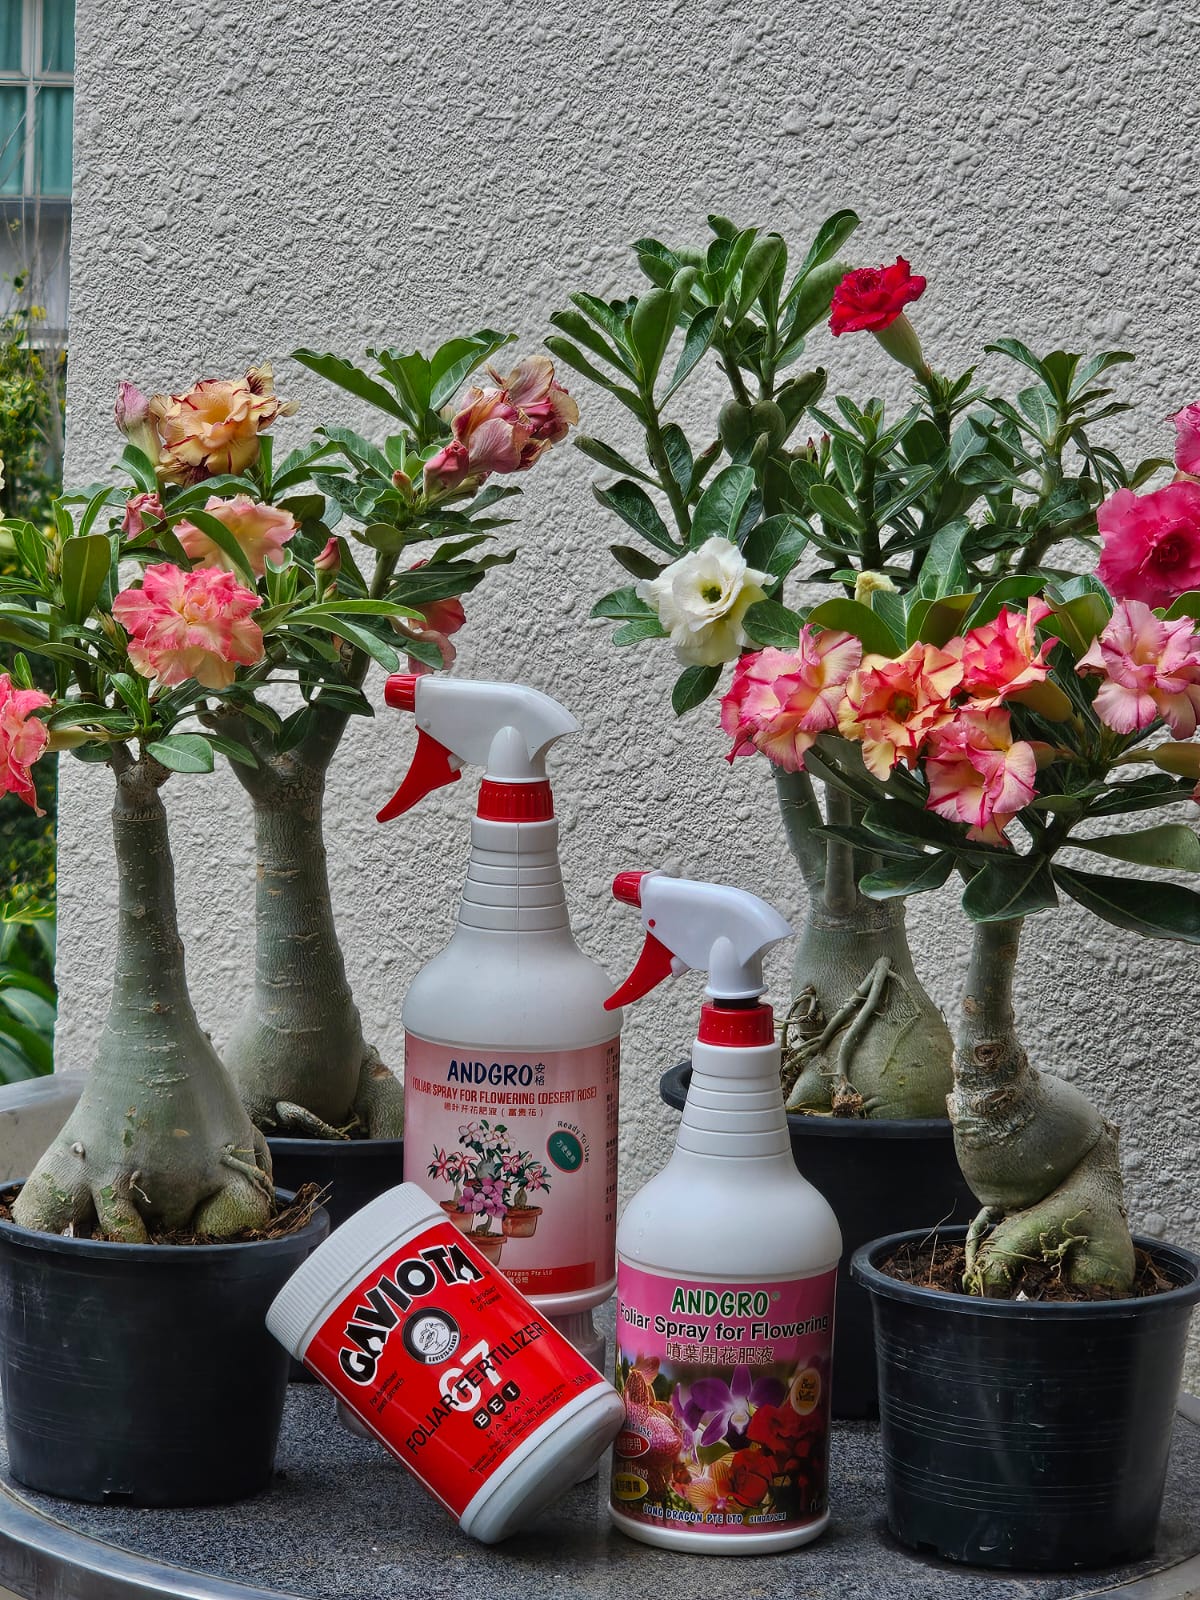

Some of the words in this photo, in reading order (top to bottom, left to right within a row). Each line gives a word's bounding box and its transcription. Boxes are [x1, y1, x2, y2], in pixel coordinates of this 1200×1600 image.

[447, 1060, 533, 1086] ANDGRO
[432, 1084, 458, 1100] SPRAY
[460, 1089, 478, 1103] FOR
[479, 1090, 535, 1105] FLOWERING
[557, 1120, 581, 1136] Ready
[338, 1242, 485, 1387] GAVIOTA
[671, 1286, 770, 1318] ANDGRO
[620, 1302, 651, 1331] Foliar
[654, 1315, 709, 1343] Spray
[715, 1322, 745, 1341] for
[750, 1314, 829, 1341] Flowering
[405, 1393, 460, 1456] FOLIAR
[454, 1320, 549, 1398] FERTILIZER
[439, 1339, 502, 1412] 67
[485, 1396, 531, 1439] HAWAII
[643, 1503, 664, 1517] LONG
[665, 1509, 703, 1523] DRAGON
[706, 1513, 723, 1525] PTE
[727, 1513, 743, 1525] LTD
